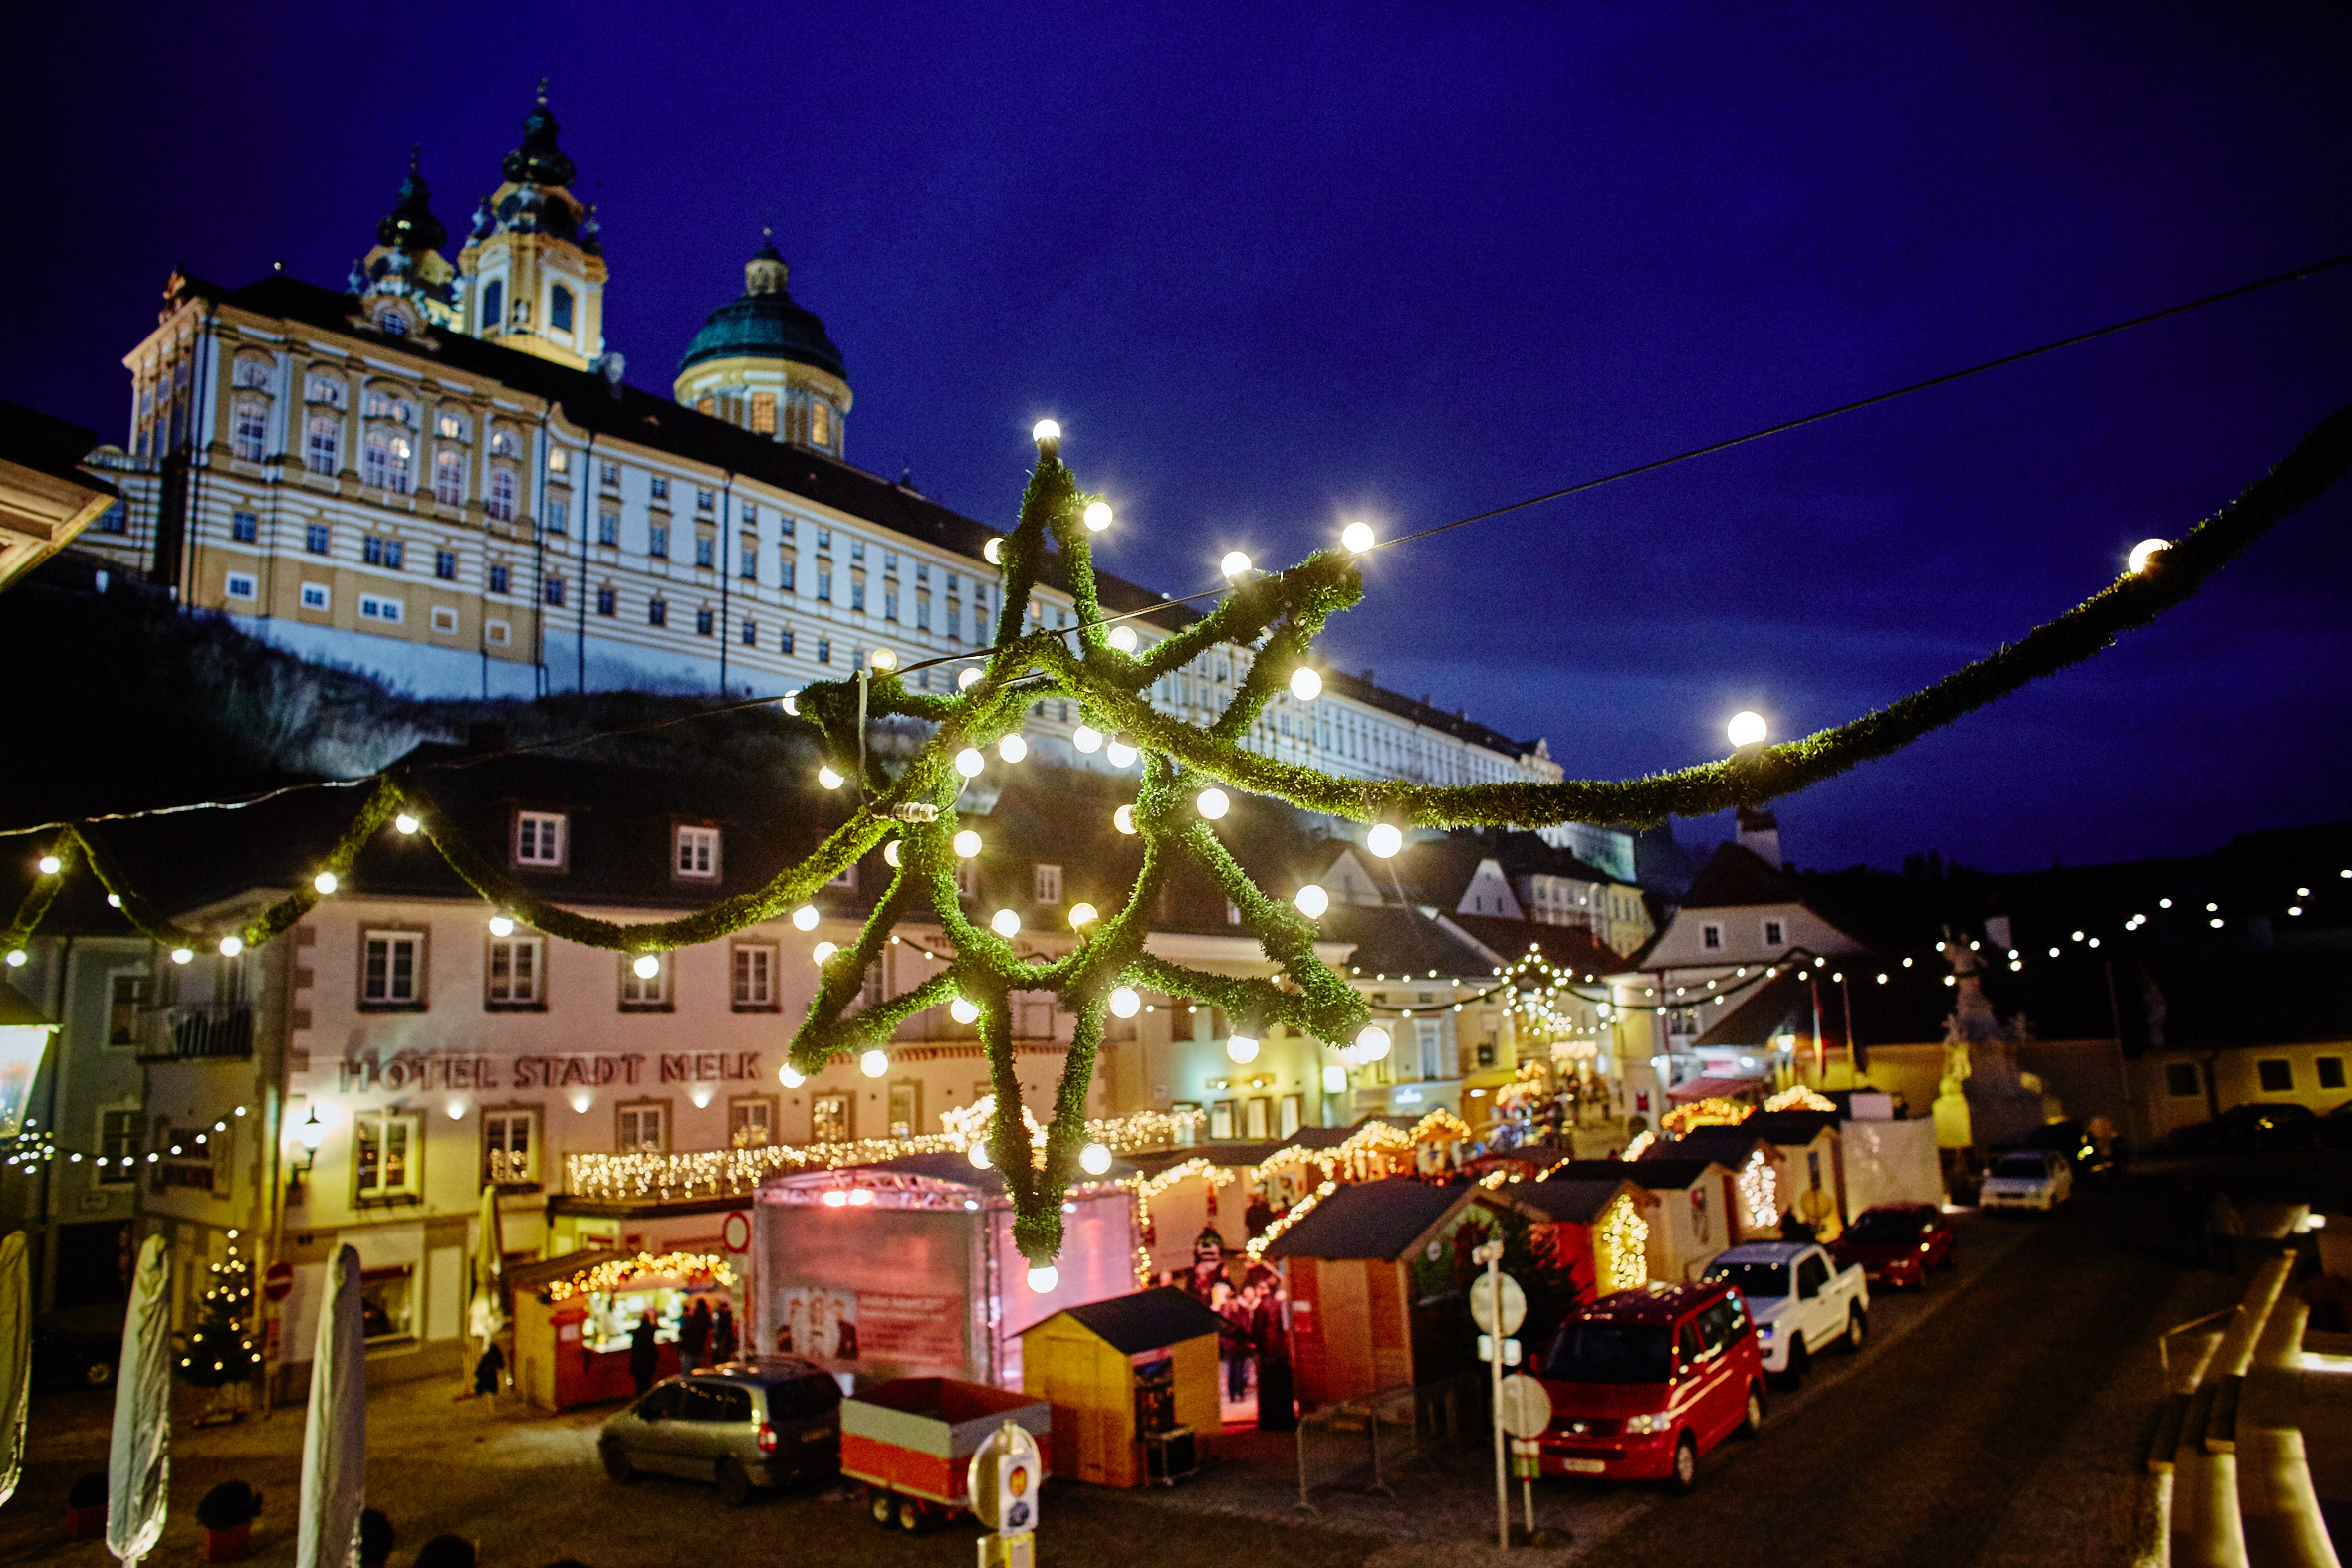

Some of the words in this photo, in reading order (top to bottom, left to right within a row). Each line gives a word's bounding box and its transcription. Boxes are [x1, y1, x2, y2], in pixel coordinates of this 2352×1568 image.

[339, 1056, 498, 1092] HOTEL
[513, 1055, 646, 1089] STADT
[660, 1052, 762, 1083] MELK
